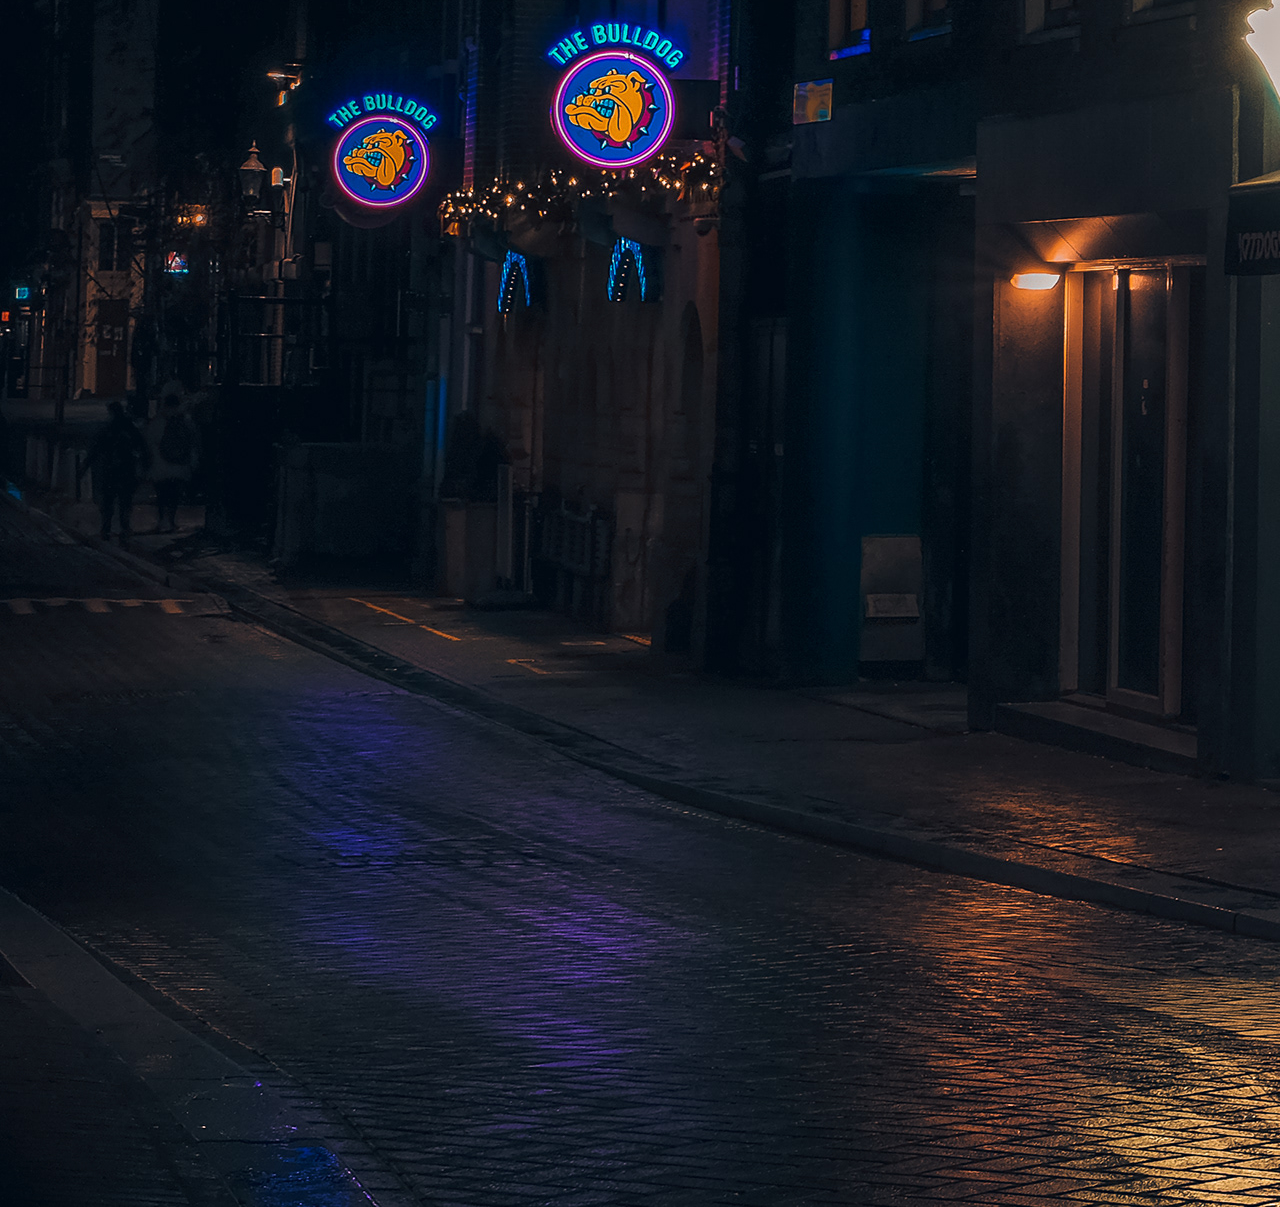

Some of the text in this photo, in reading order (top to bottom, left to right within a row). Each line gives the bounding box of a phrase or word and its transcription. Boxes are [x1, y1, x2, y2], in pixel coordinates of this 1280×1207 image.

[548, 23, 684, 68] THE BULLDOG
[328, 93, 437, 130] THE BULLDOG
